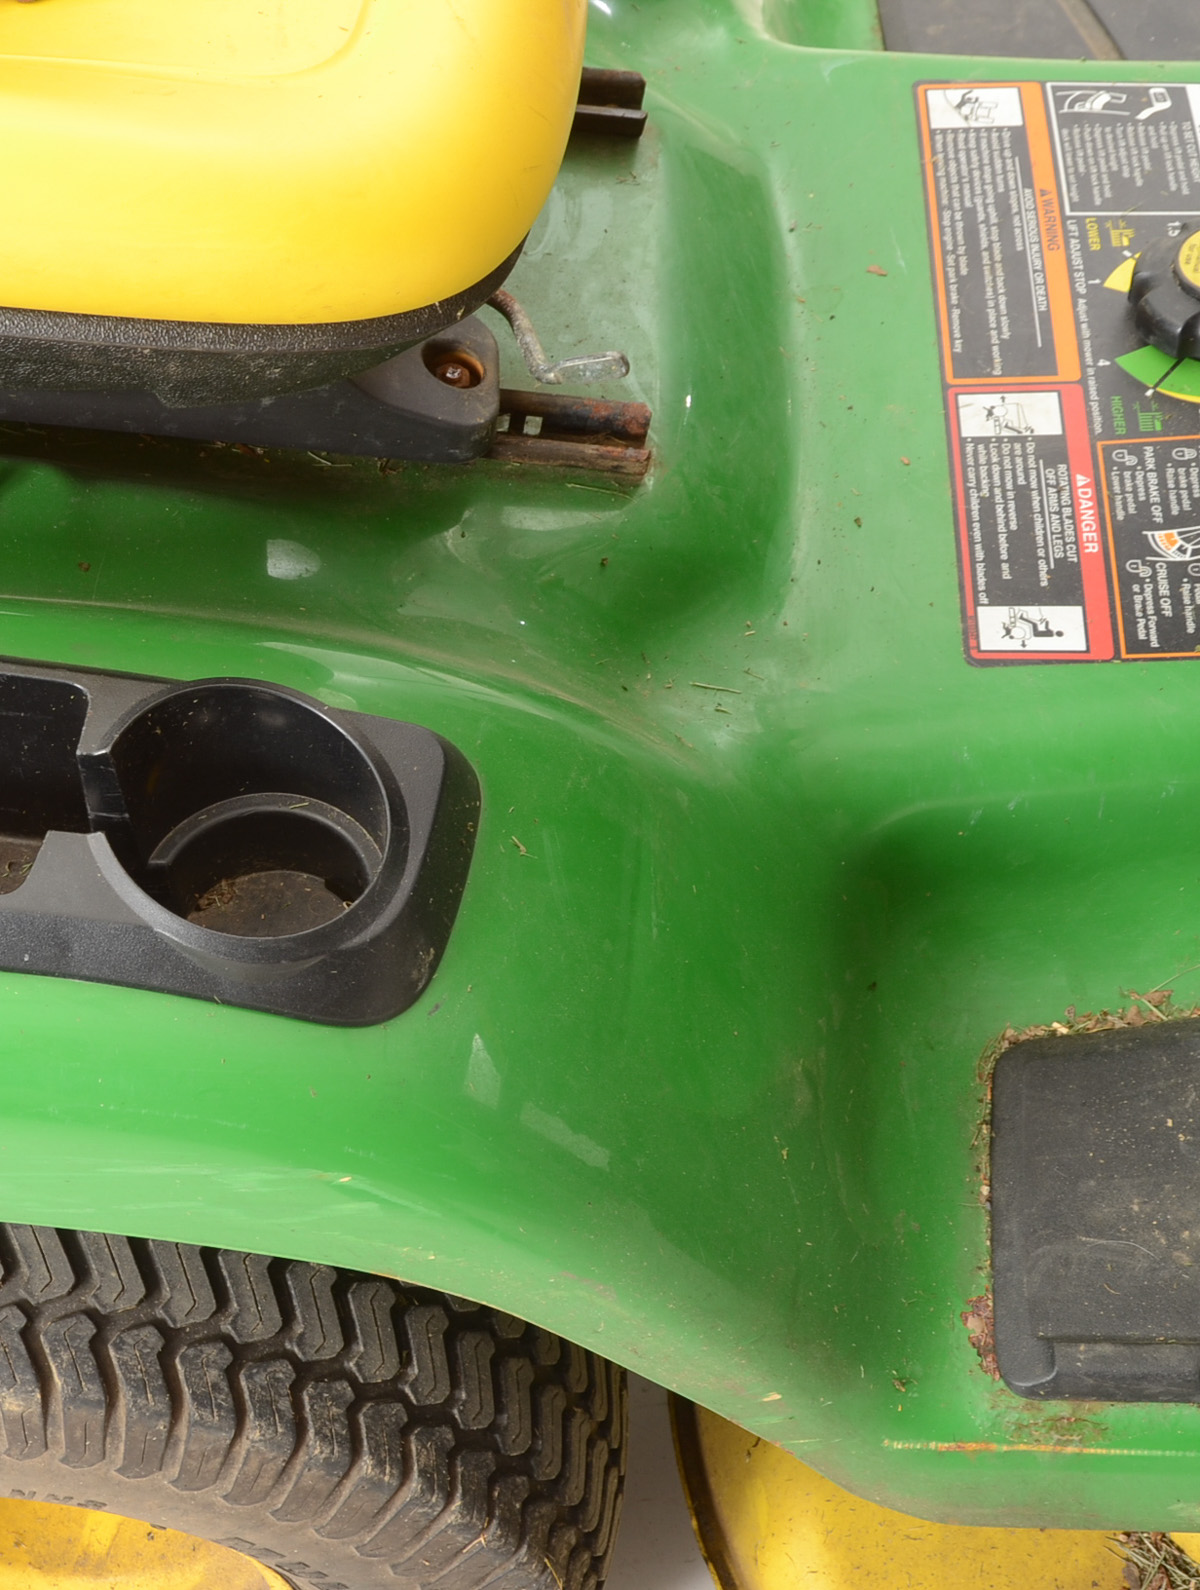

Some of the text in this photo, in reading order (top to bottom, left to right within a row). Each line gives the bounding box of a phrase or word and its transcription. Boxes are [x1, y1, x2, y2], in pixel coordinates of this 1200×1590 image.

[1023, 188, 1046, 311] AVOID SERIOUS INJURY OR DEATH
[1041, 198, 1060, 250] WARNING
[1085, 217, 1100, 250] LOWER
[1167, 220, 1180, 236] 1.5
[1066, 219, 1102, 434] LIFT ADJUST STOP Adjust with mower in raised position.
[1096, 358, 1110, 366] 4
[1110, 395, 1126, 434] HIGHER
[977, 443, 987, 464] while
[1013, 442, 1026, 484] are around
[989, 442, 1012, 579] Look down and behind before and
[1001, 442, 1017, 530] Do not mow in reverse
[1110, 470, 1125, 520] Lower handle
[1122, 470, 1136, 514] brake pedal
[1134, 470, 1145, 501] Depress
[1143, 445, 1163, 523] PARK BRAKE OFF
[1165, 467, 1179, 515] Raise handle
[1177, 467, 1191, 510] brake pedal
[965, 442, 989, 604] Never carry children even with blades off
[1025, 441, 1050, 586] Do not mow when children or others
[1044, 467, 1064, 558] OFF ARMS AND LEGS
[1057, 463, 1077, 562] ROTATING BLADES CUT
[1077, 487, 1098, 552] DANGER
[1131, 583, 1140, 592] or
[1136, 617, 1147, 639] Pedal
[1142, 583, 1159, 647] Depress Forward
[1155, 562, 1172, 616] CRUISE OFF
[1179, 583, 1195, 633] Raise handle
